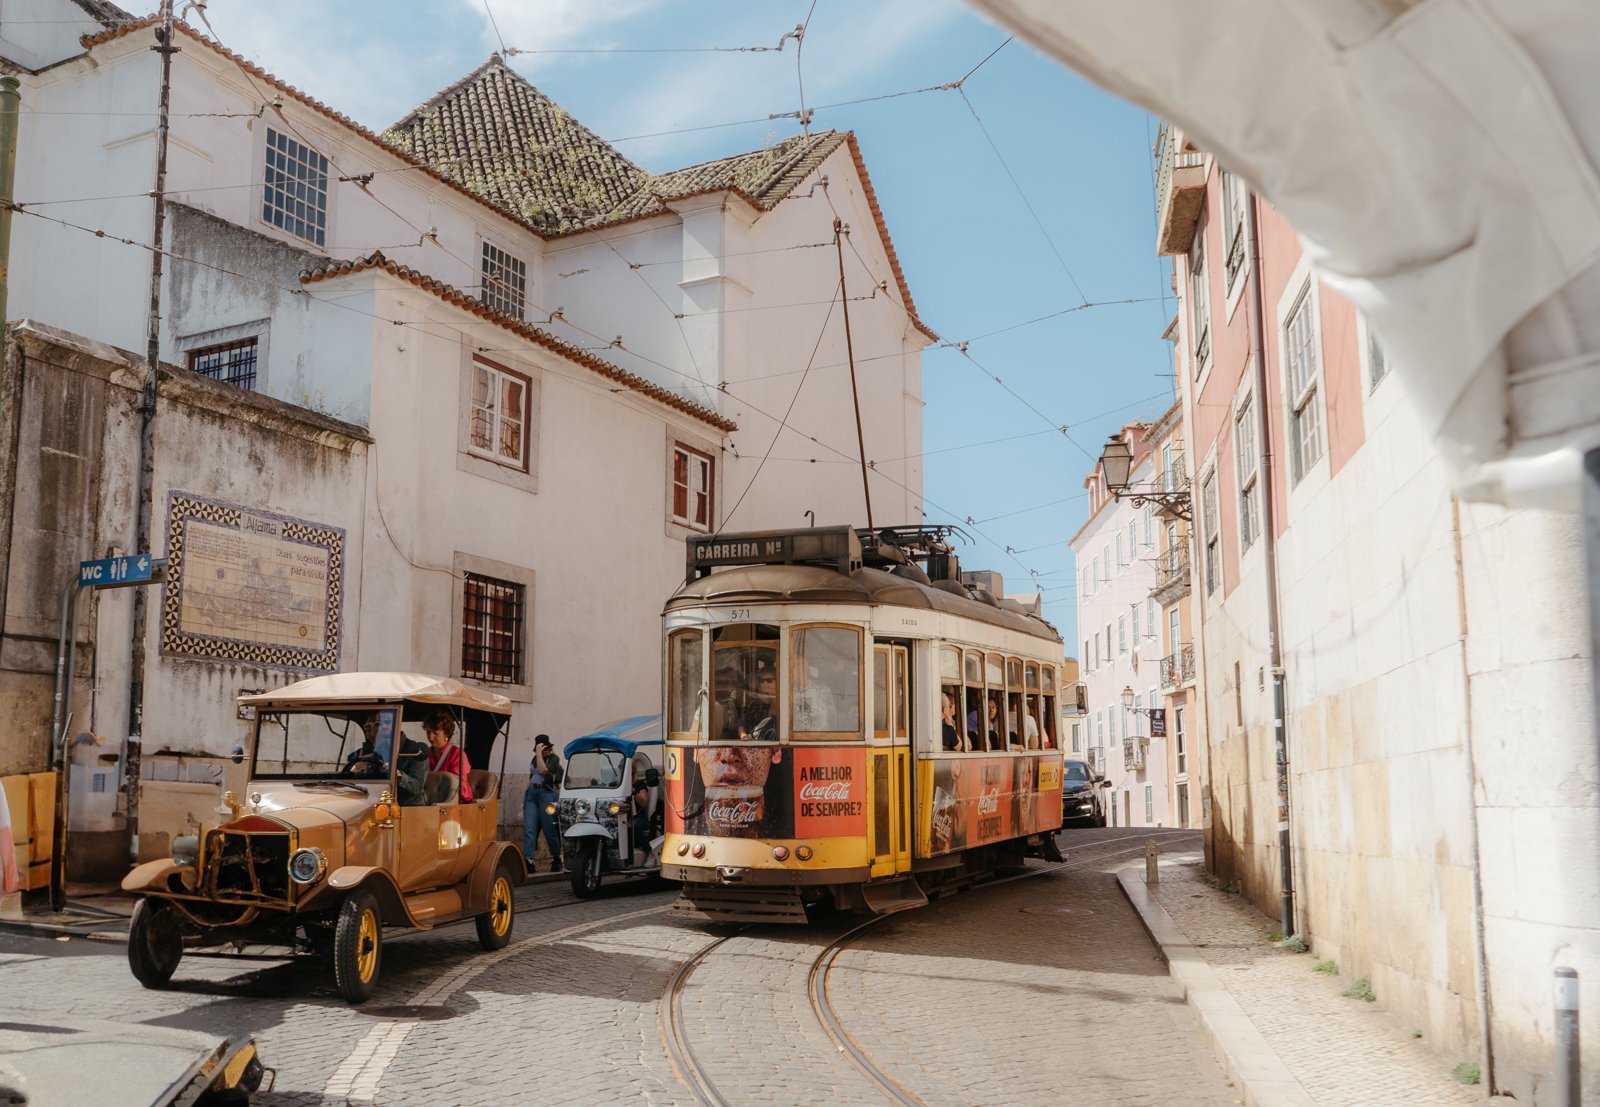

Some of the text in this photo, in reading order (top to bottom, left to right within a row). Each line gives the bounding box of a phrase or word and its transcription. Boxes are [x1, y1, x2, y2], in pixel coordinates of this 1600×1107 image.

[246, 516, 276, 535] Alfama
[275, 548, 293, 560] Duas
[697, 543, 759, 560] CARREIRA
[82, 565, 102, 580] WC
[290, 567, 306, 577] para
[731, 609, 750, 620] 571
[800, 766, 852, 781] A MELHOR
[801, 801, 862, 817] DE SEMPRE?
